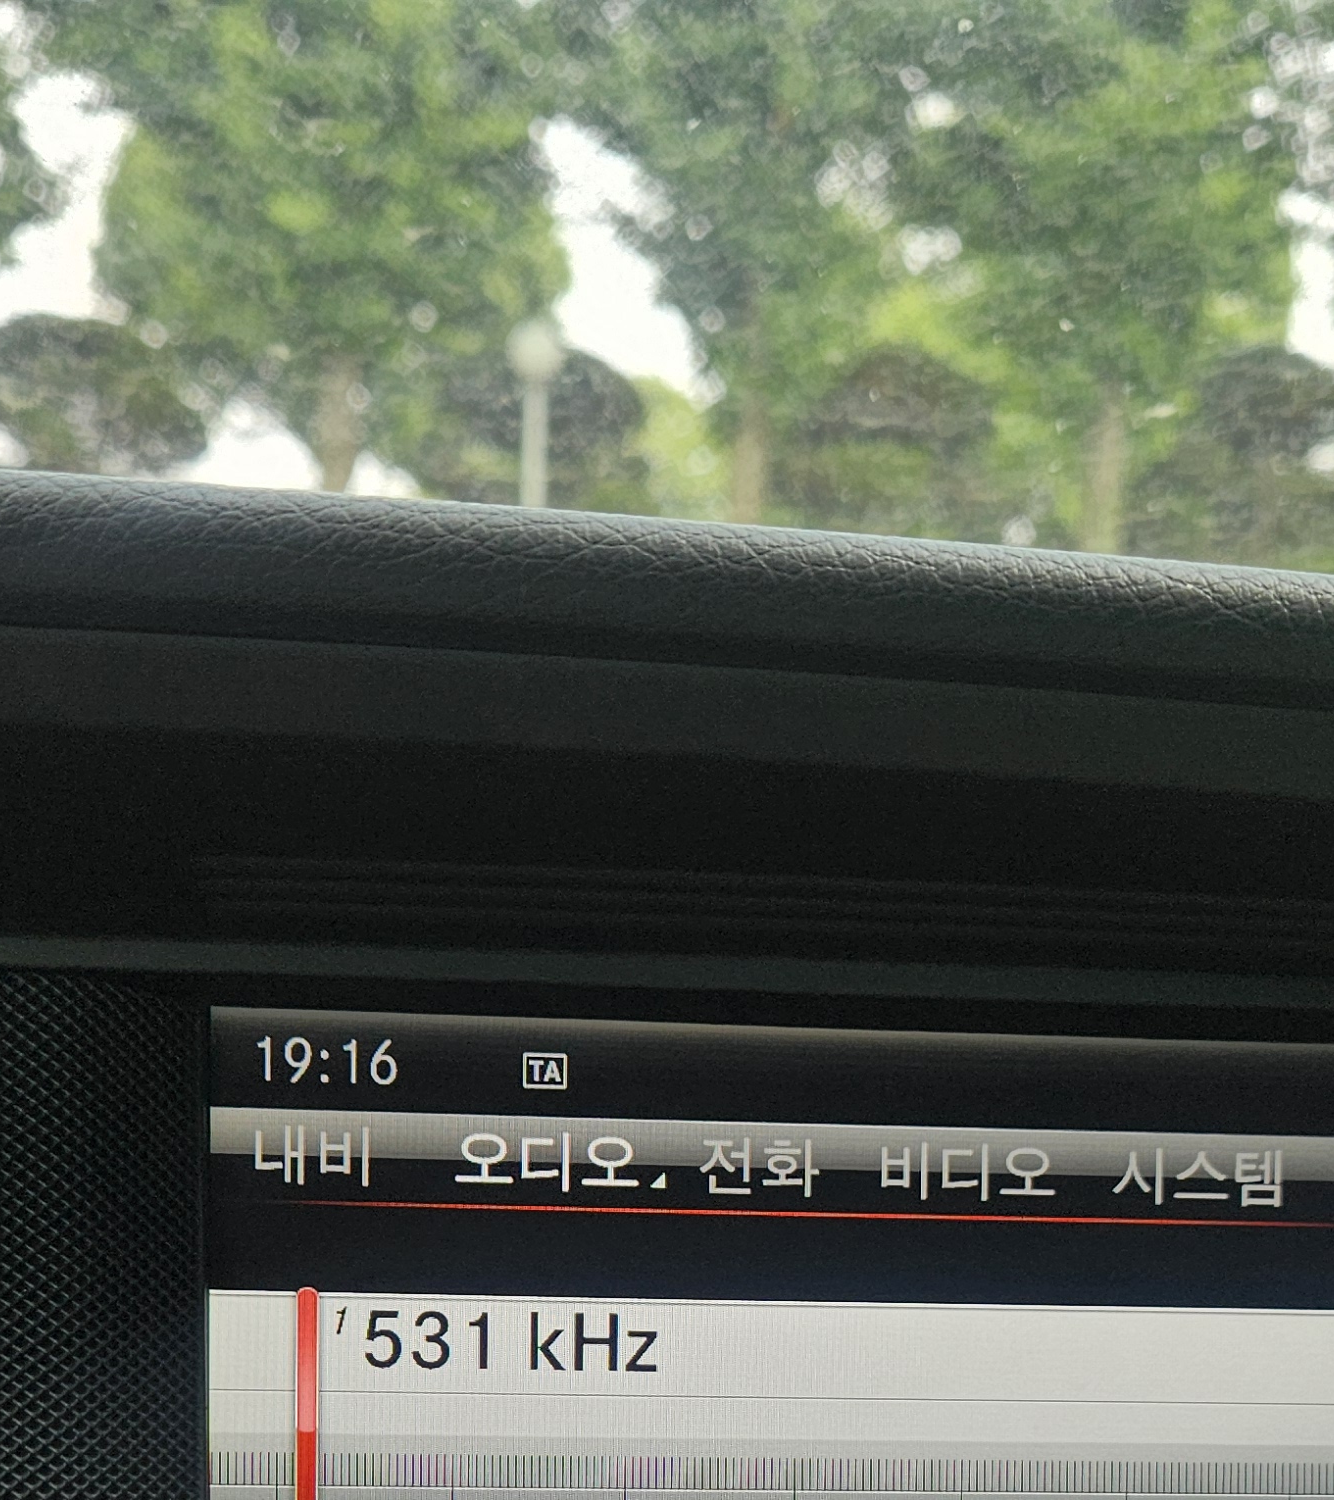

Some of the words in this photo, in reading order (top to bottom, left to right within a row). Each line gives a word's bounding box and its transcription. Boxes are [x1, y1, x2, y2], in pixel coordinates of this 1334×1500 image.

[256, 1035, 398, 1086] 19:16
[528, 1059, 562, 1083] TA
[254, 1125, 370, 1188] 내비
[454, 1132, 640, 1193] 오디오
[699, 1135, 820, 1198] 전화
[880, 1141, 1056, 1201] 비디오
[1112, 1147, 1284, 1208] 시스템
[364, 1309, 490, 1371] 531
[530, 1311, 658, 1374] kHz
